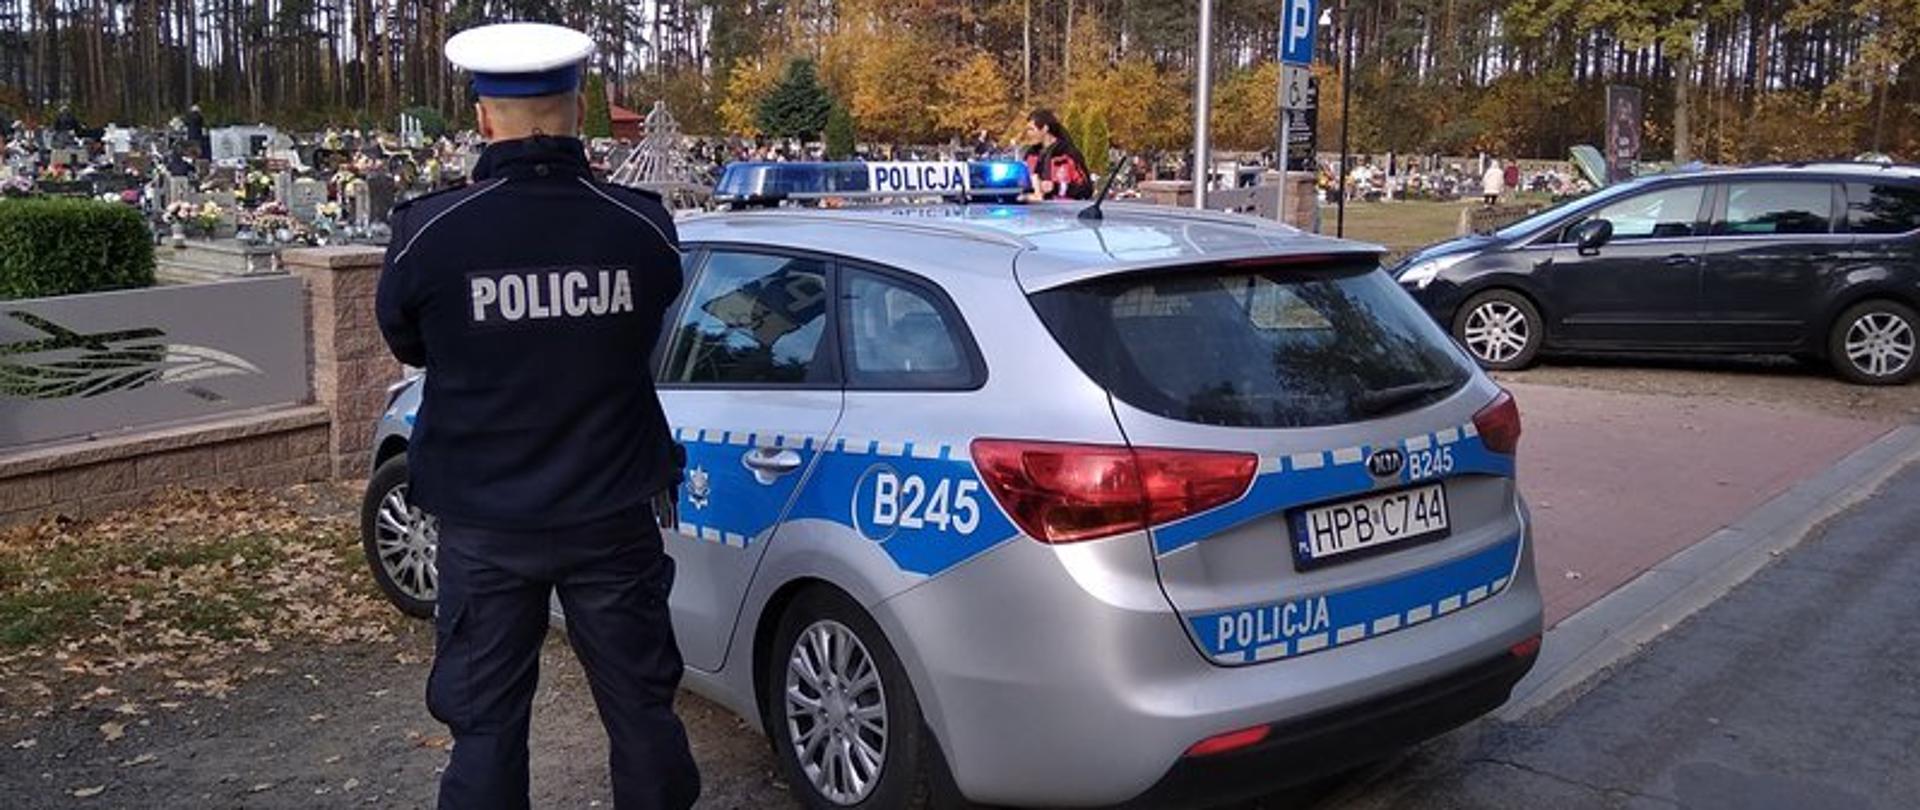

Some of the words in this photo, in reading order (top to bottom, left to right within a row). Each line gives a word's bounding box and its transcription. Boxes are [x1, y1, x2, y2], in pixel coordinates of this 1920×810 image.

[1289, 0, 1311, 53] P
[875, 166, 965, 191] POLICJA
[471, 269, 633, 321] POLICJA
[1410, 445, 1454, 481] B245
[873, 472, 980, 534] B245
[1313, 503, 1374, 552] HPB
[1381, 488, 1443, 536] C744
[1219, 596, 1330, 651] POLICJA
